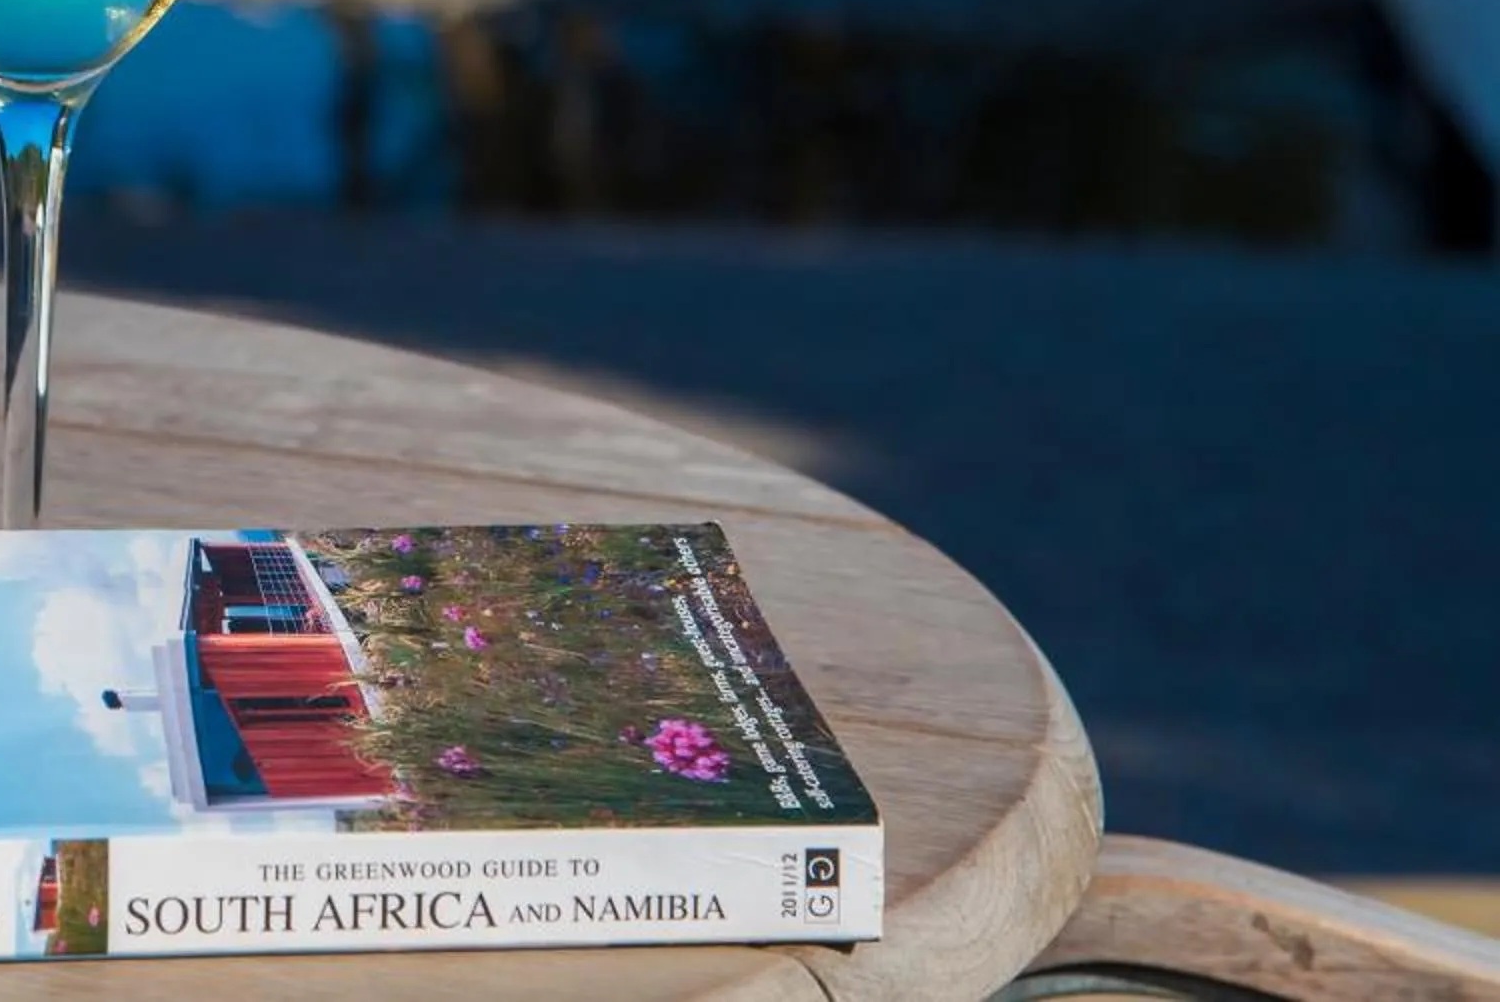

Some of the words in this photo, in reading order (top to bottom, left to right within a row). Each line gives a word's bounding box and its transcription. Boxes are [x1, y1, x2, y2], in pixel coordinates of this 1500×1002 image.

[673, 537, 702, 575] others
[732, 665, 760, 686] and
[752, 742, 786, 773] game
[259, 863, 306, 882] THE
[316, 860, 472, 881] GREENWOOD
[483, 858, 558, 878] GUIDE
[569, 858, 600, 877] TO
[780, 852, 799, 919] 2011/12
[125, 894, 297, 936] SOUTH
[311, 891, 498, 931] AFRICA
[509, 902, 562, 923] AND
[572, 893, 727, 923] NAMIBIA
